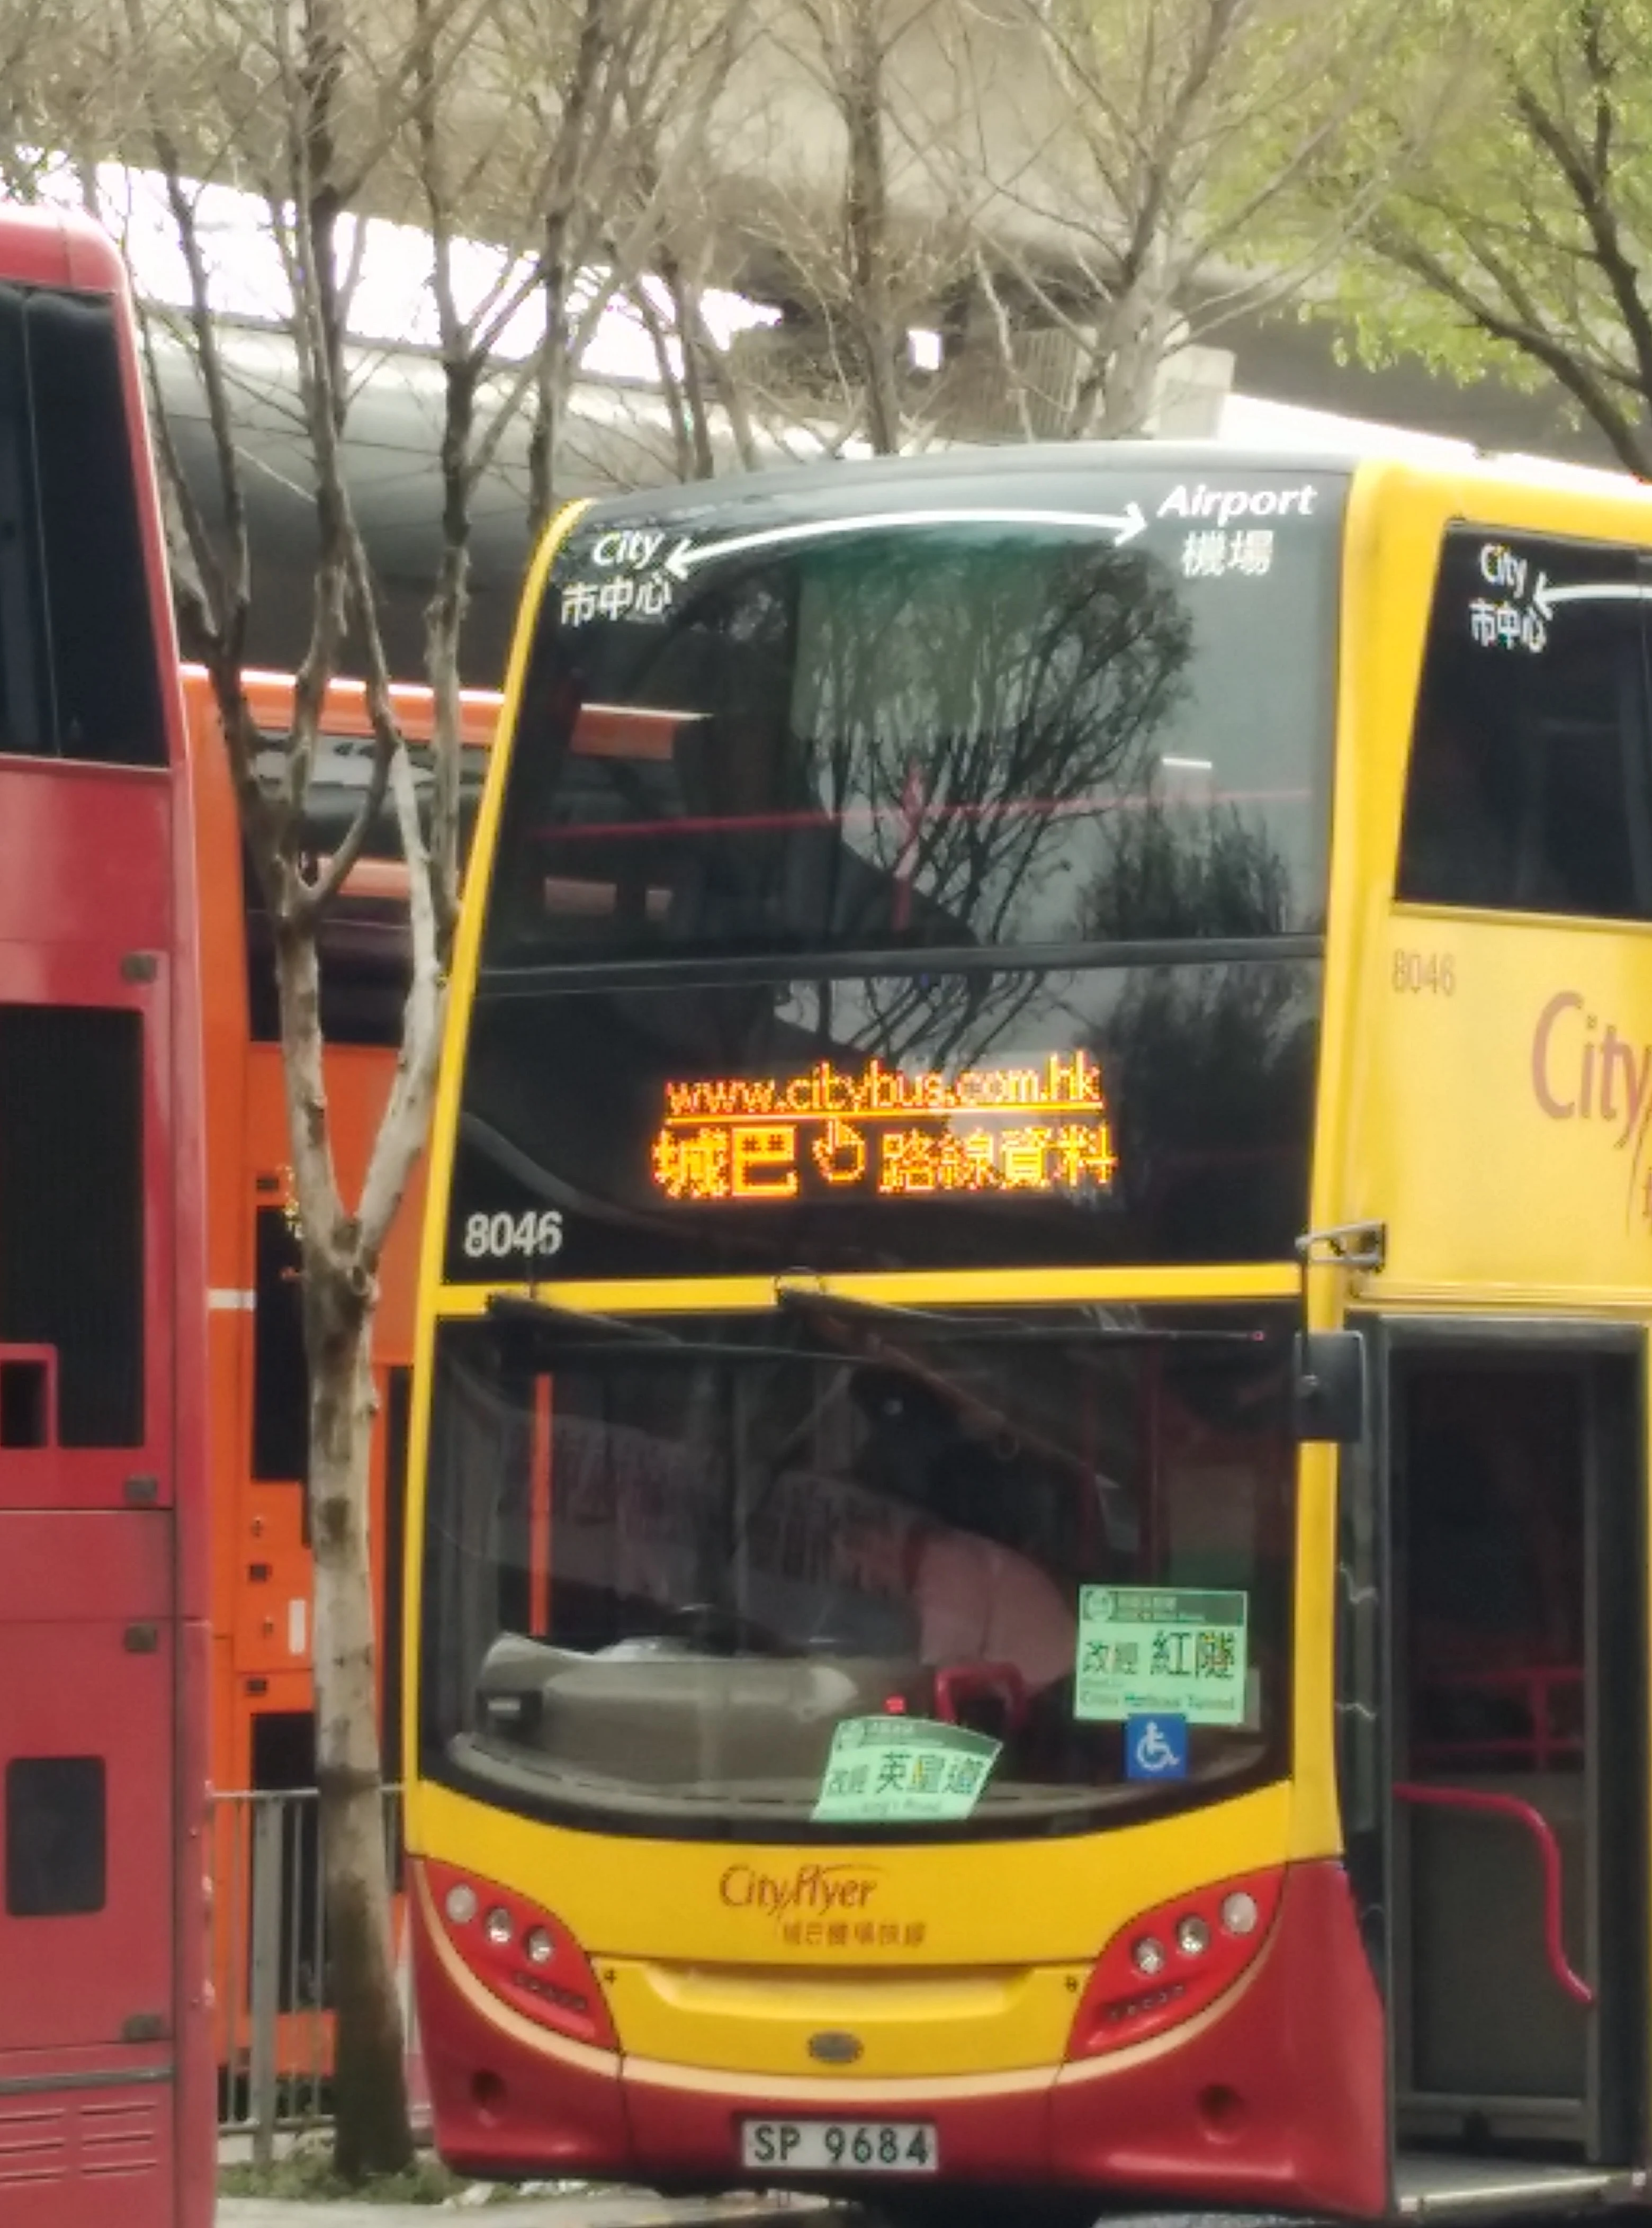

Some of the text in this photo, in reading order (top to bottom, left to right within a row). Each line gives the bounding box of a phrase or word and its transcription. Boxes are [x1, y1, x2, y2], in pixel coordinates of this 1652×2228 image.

[1156, 485, 1317, 527] Airport
[593, 531, 665, 570] City
[1182, 529, 1273, 578] 機場
[1480, 543, 1528, 599] City
[561, 571, 673, 627] 市中心
[1469, 598, 1547, 653] 市中心
[1392, 949, 1455, 996] 8046
[666, 1050, 1102, 1116] www.citybus.com.hk
[651, 1120, 1118, 1200] 城巴 路線資料
[464, 1210, 563, 1258] 8046
[754, 2125, 929, 2166] SP 9684
